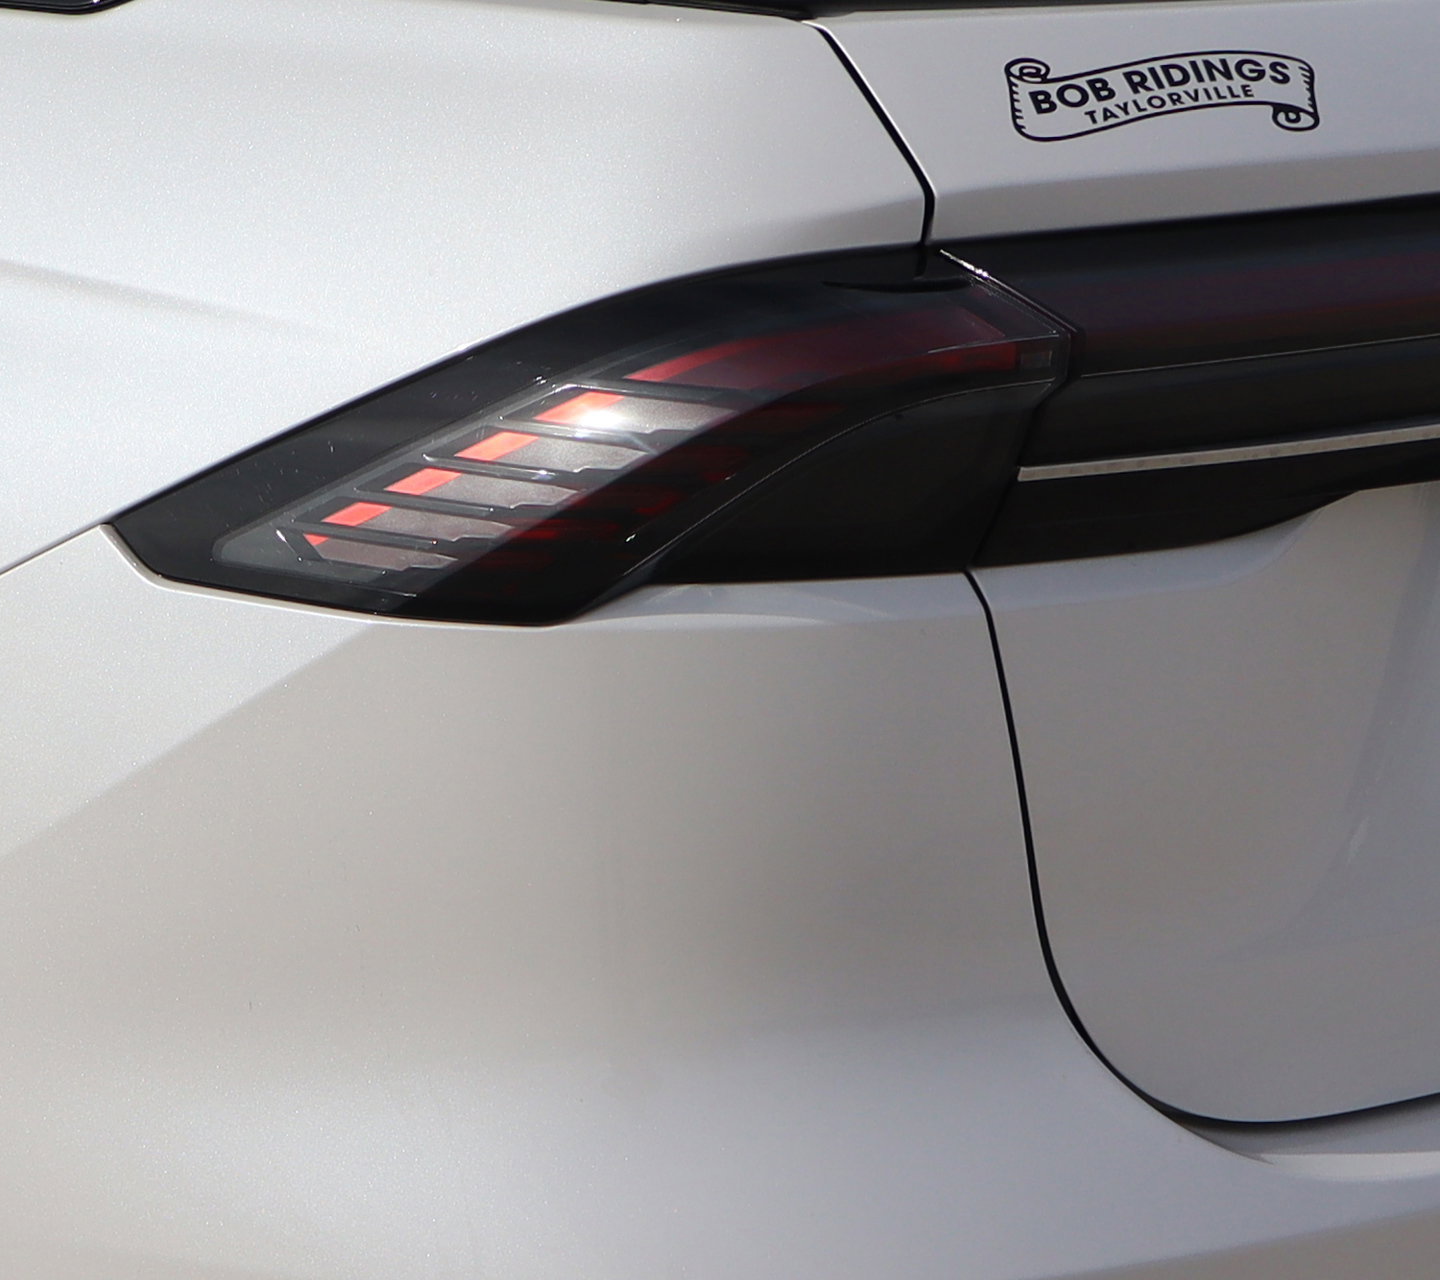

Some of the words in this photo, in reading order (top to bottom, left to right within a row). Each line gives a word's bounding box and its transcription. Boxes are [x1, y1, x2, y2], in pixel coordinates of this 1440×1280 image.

[1029, 77, 1116, 114] BOB
[1122, 58, 1291, 94] RIDINGS
[1084, 84, 1254, 125] TAYLORVILLE
